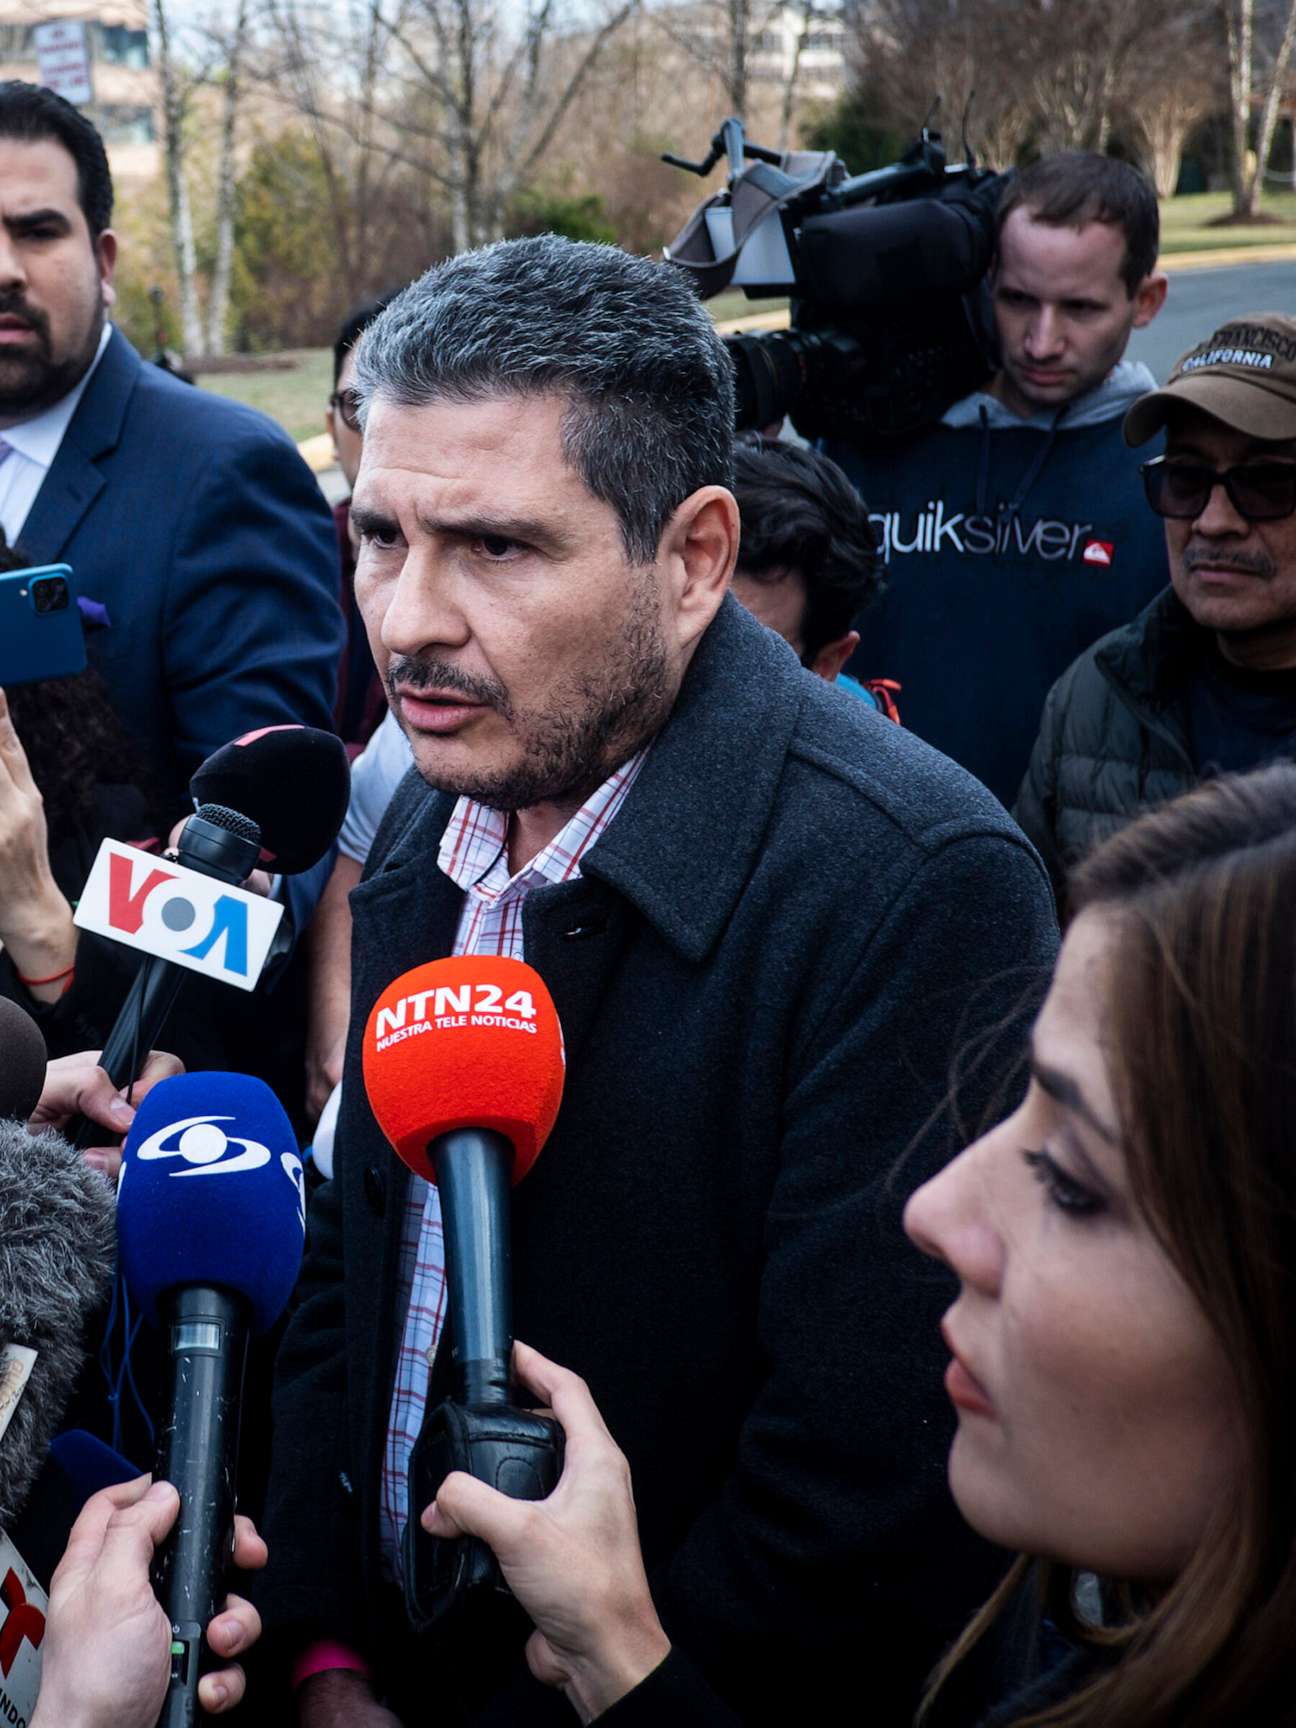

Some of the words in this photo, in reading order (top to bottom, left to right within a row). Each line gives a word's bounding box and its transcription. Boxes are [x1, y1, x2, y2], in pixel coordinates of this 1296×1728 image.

[1182, 349, 1272, 371] CALIFORNIA
[109, 852, 247, 976] VOA
[376, 984, 536, 1039] NTN24
[377, 1022, 432, 1052] NUESTRA
[435, 1015, 467, 1029] TELE
[470, 1015, 537, 1034] NOTICIAS
